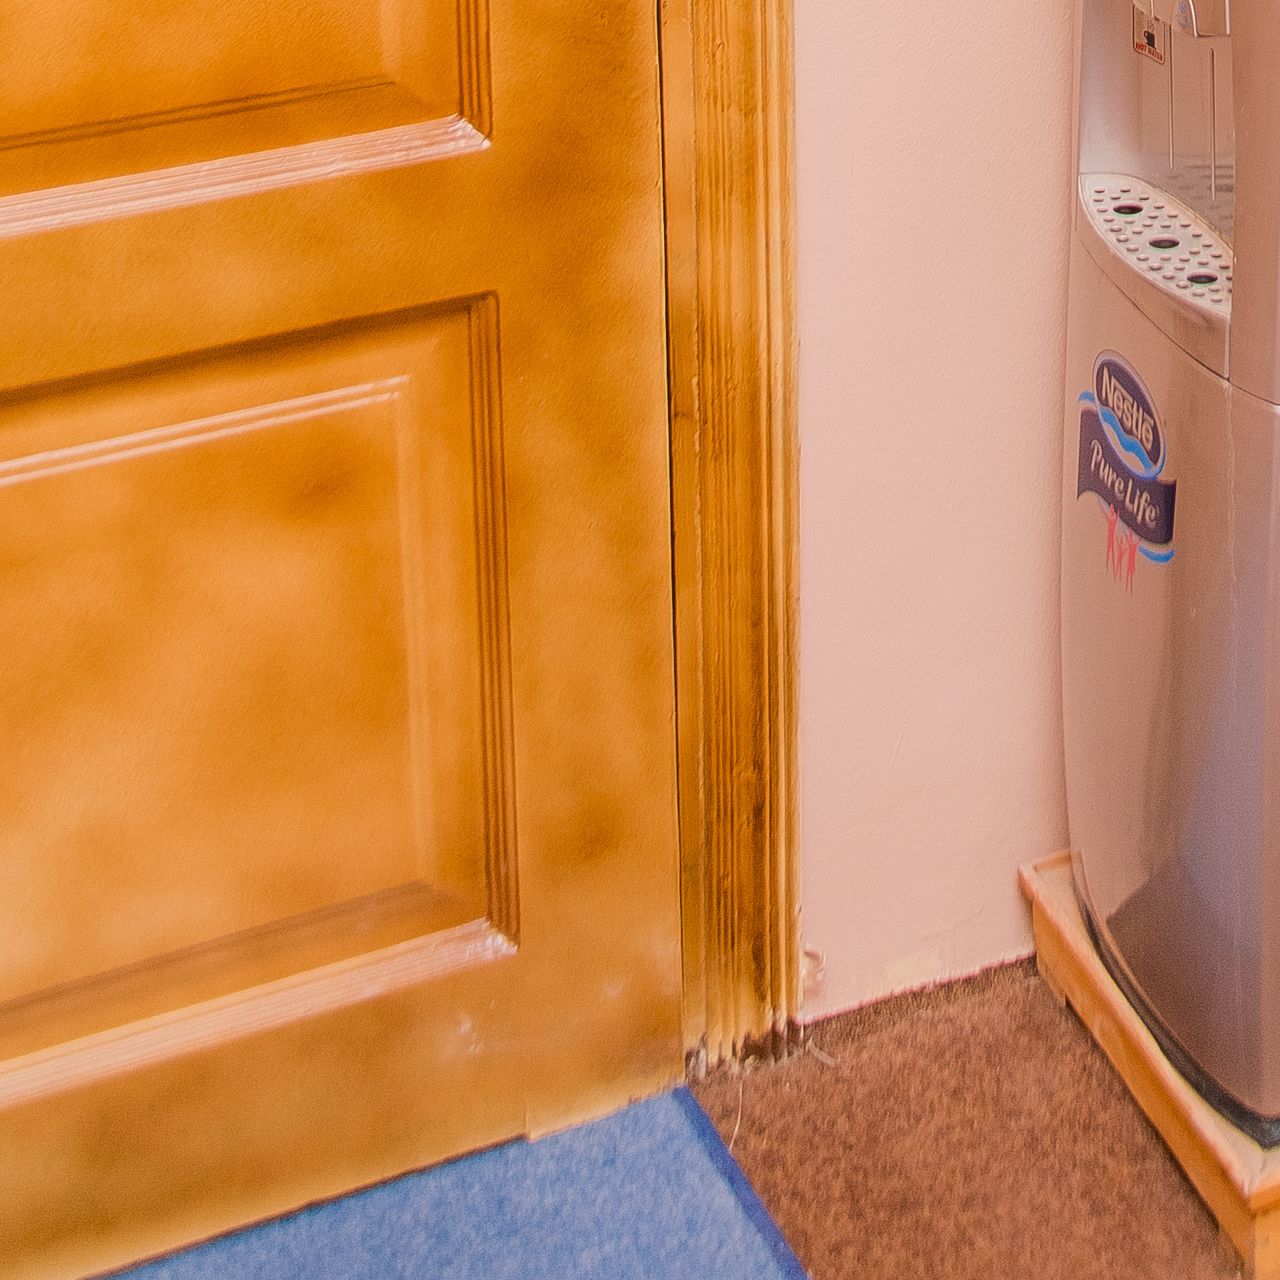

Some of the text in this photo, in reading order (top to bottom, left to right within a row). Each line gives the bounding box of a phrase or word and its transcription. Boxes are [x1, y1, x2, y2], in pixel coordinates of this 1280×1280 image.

[1101, 365, 1154, 452] Nestlé
[1090, 439, 1156, 526] Pure Life
